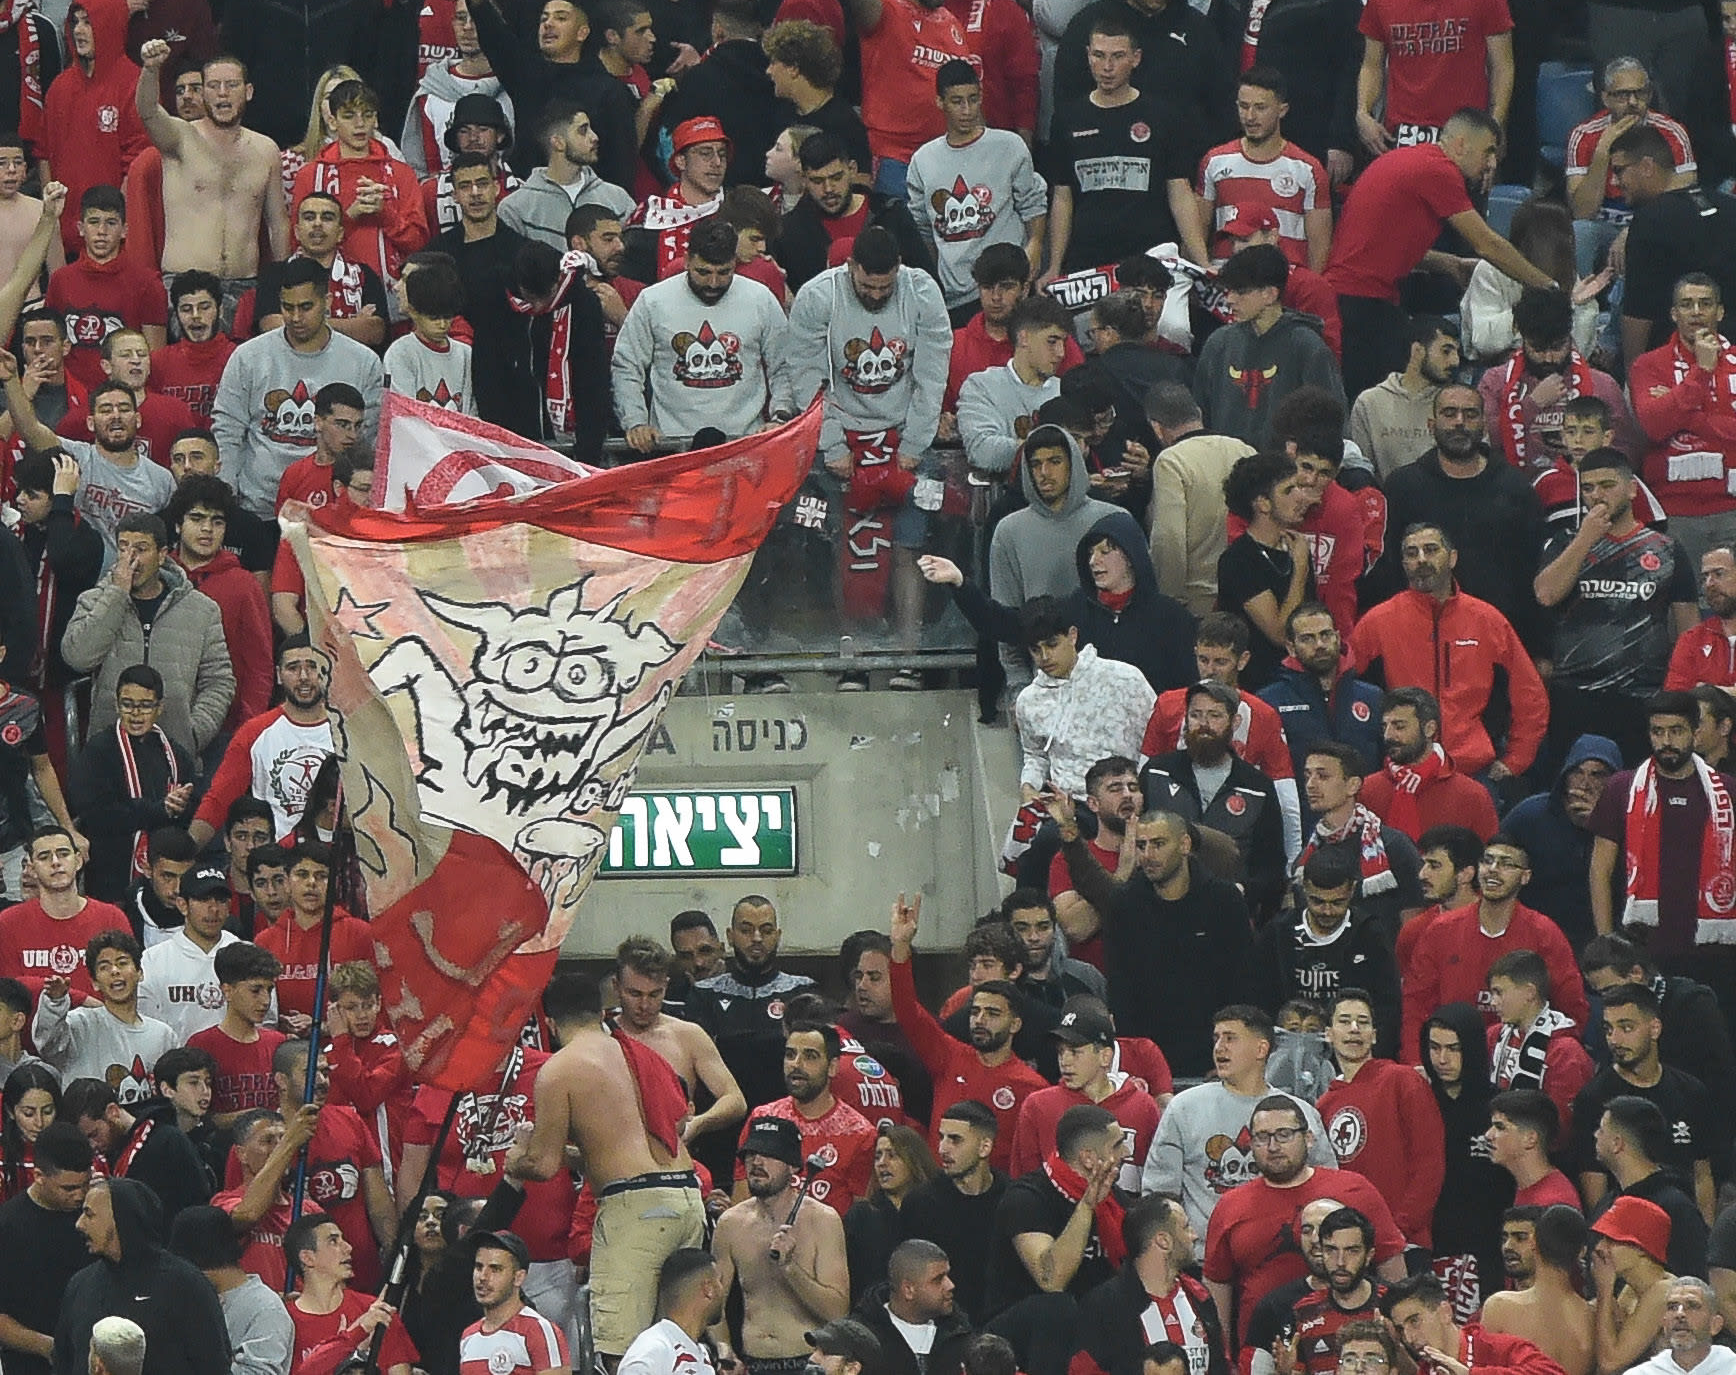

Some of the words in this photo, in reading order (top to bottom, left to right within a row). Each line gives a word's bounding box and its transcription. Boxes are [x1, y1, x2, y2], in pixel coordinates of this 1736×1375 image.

[1579, 578, 1639, 594] הכשרה
[644, 725, 677, 756] A
[713, 718, 809, 753] כניסה
[609, 794, 784, 868] יציאה
[22, 949, 50, 968] UH
[167, 985, 196, 1003] UH
